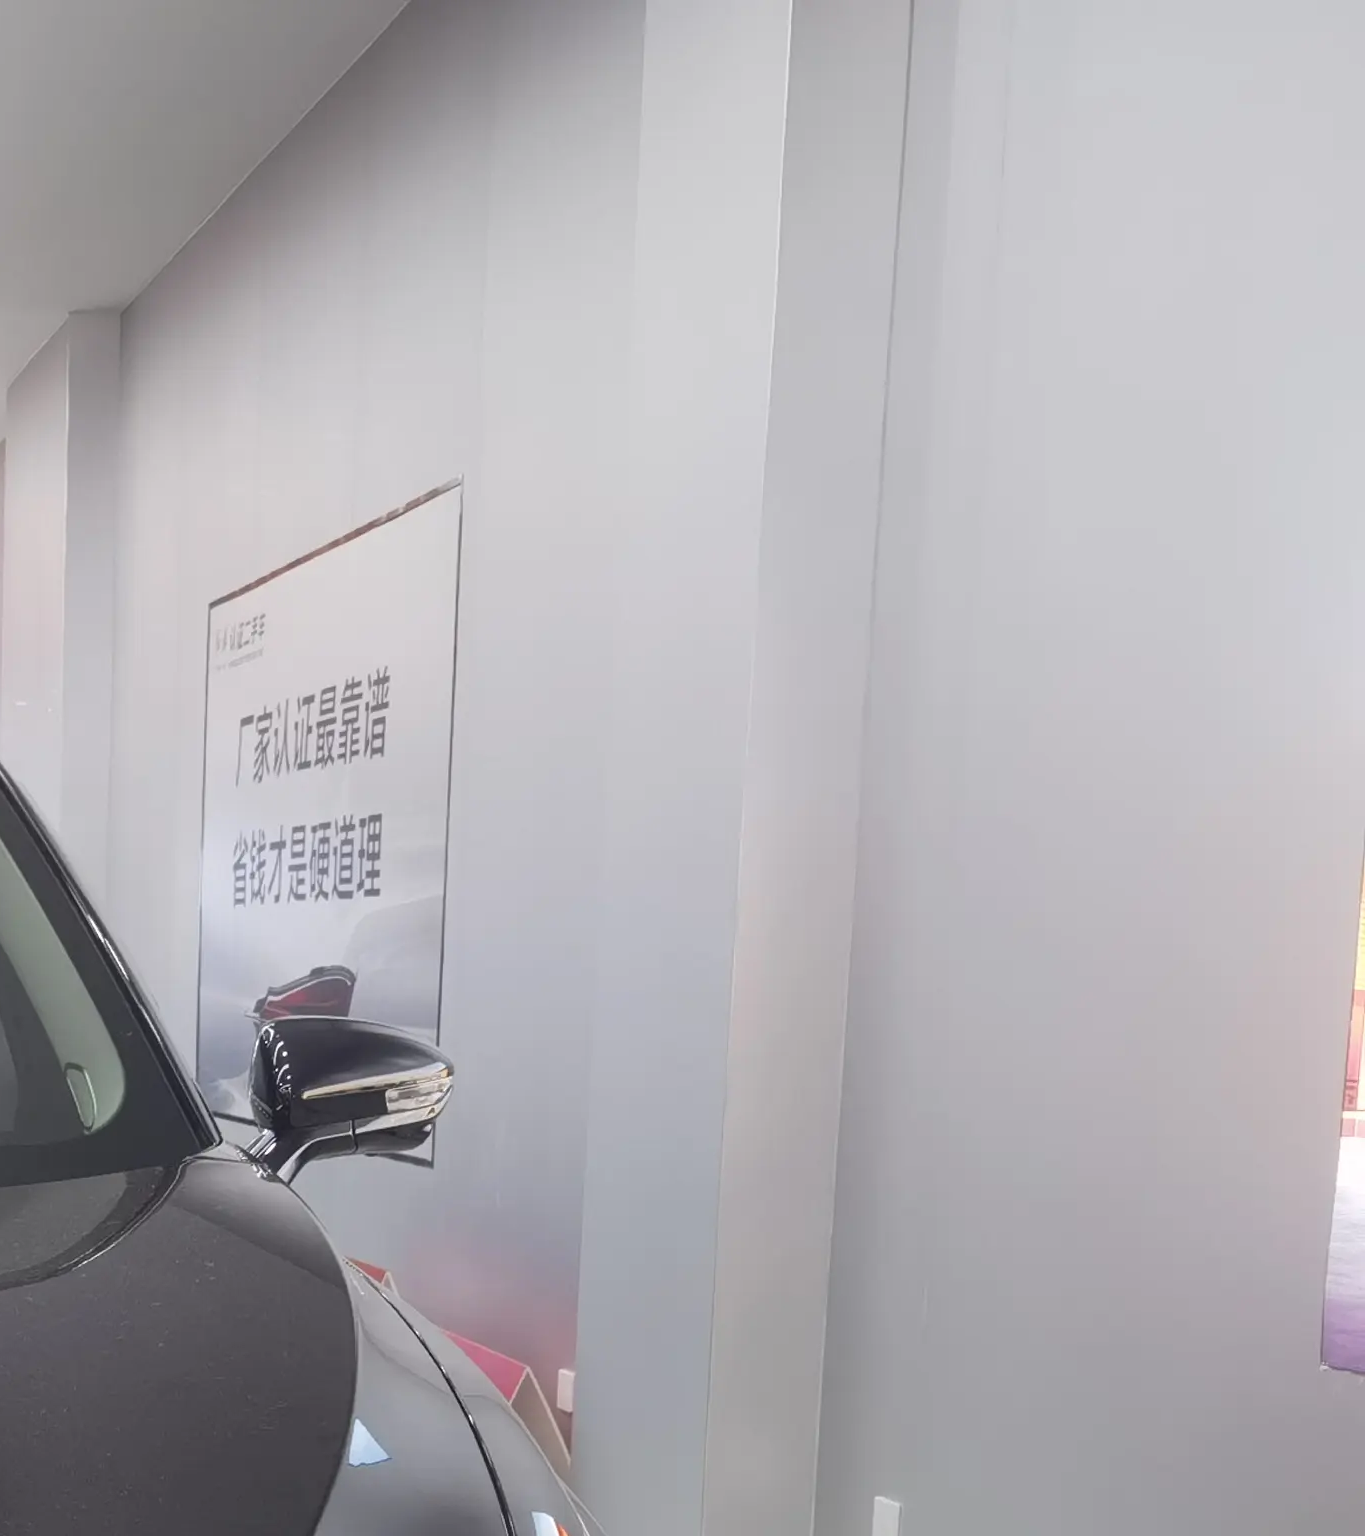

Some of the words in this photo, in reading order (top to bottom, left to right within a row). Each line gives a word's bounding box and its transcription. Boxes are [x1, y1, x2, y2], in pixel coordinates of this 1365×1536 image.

[235, 665, 390, 788] 厂家认证最靠谱
[233, 812, 383, 908] 省钱才是硬道理
